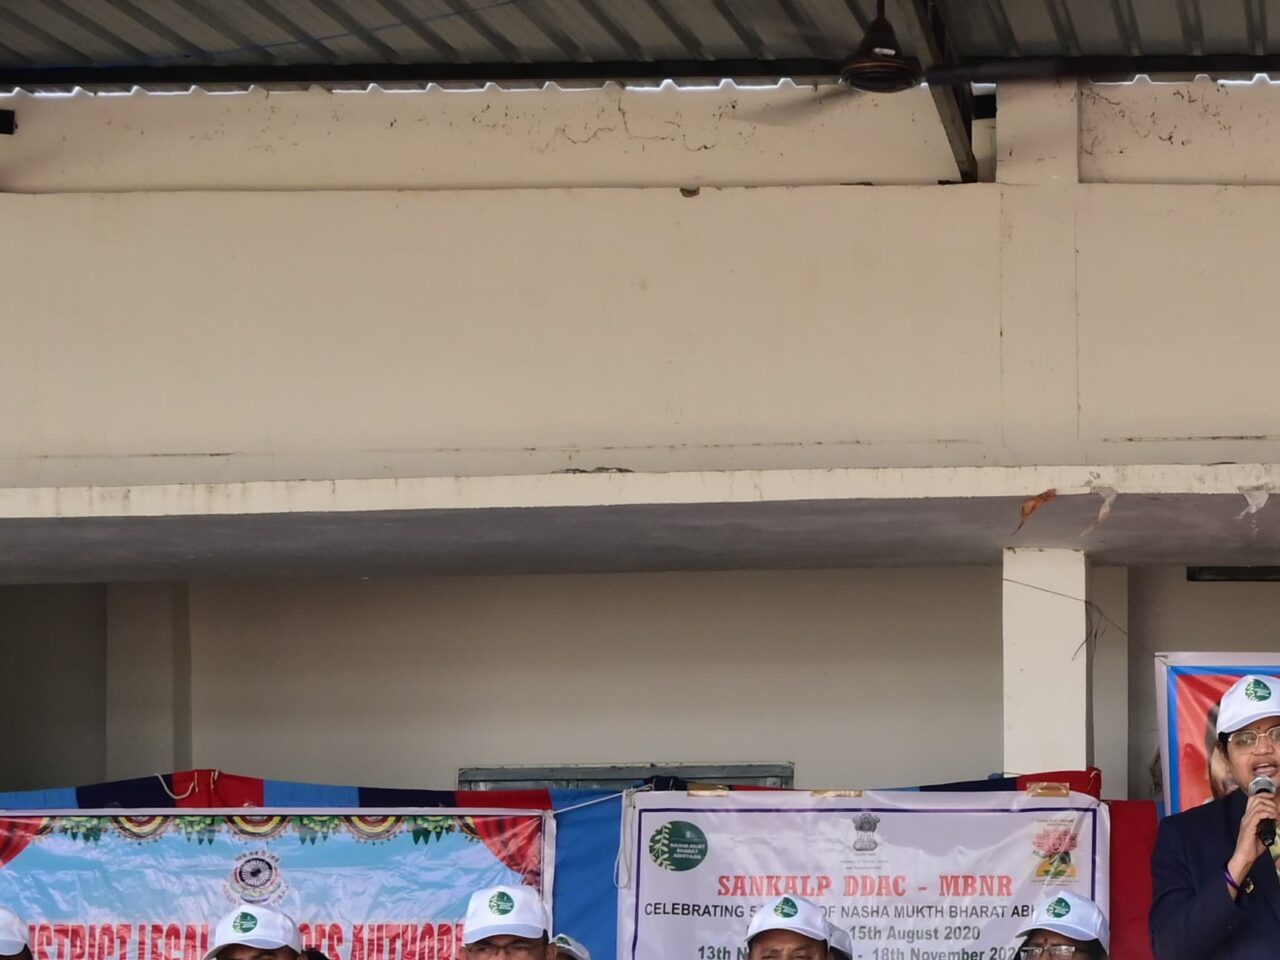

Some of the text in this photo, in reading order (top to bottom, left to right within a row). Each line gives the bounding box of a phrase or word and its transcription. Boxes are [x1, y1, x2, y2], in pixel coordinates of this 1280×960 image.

[717, 875, 832, 897] SANKALP
[843, 875, 906, 897] DDAC
[938, 875, 1013, 897] MBNR
[645, 902, 745, 919] CELEBRATING
[841, 905, 890, 919] NASHA
[894, 905, 944, 919] MUKTH
[949, 905, 1008, 919] BHARAT
[850, 925, 981, 944] 15th August 2020
[698, 945, 731, 960] 13th
